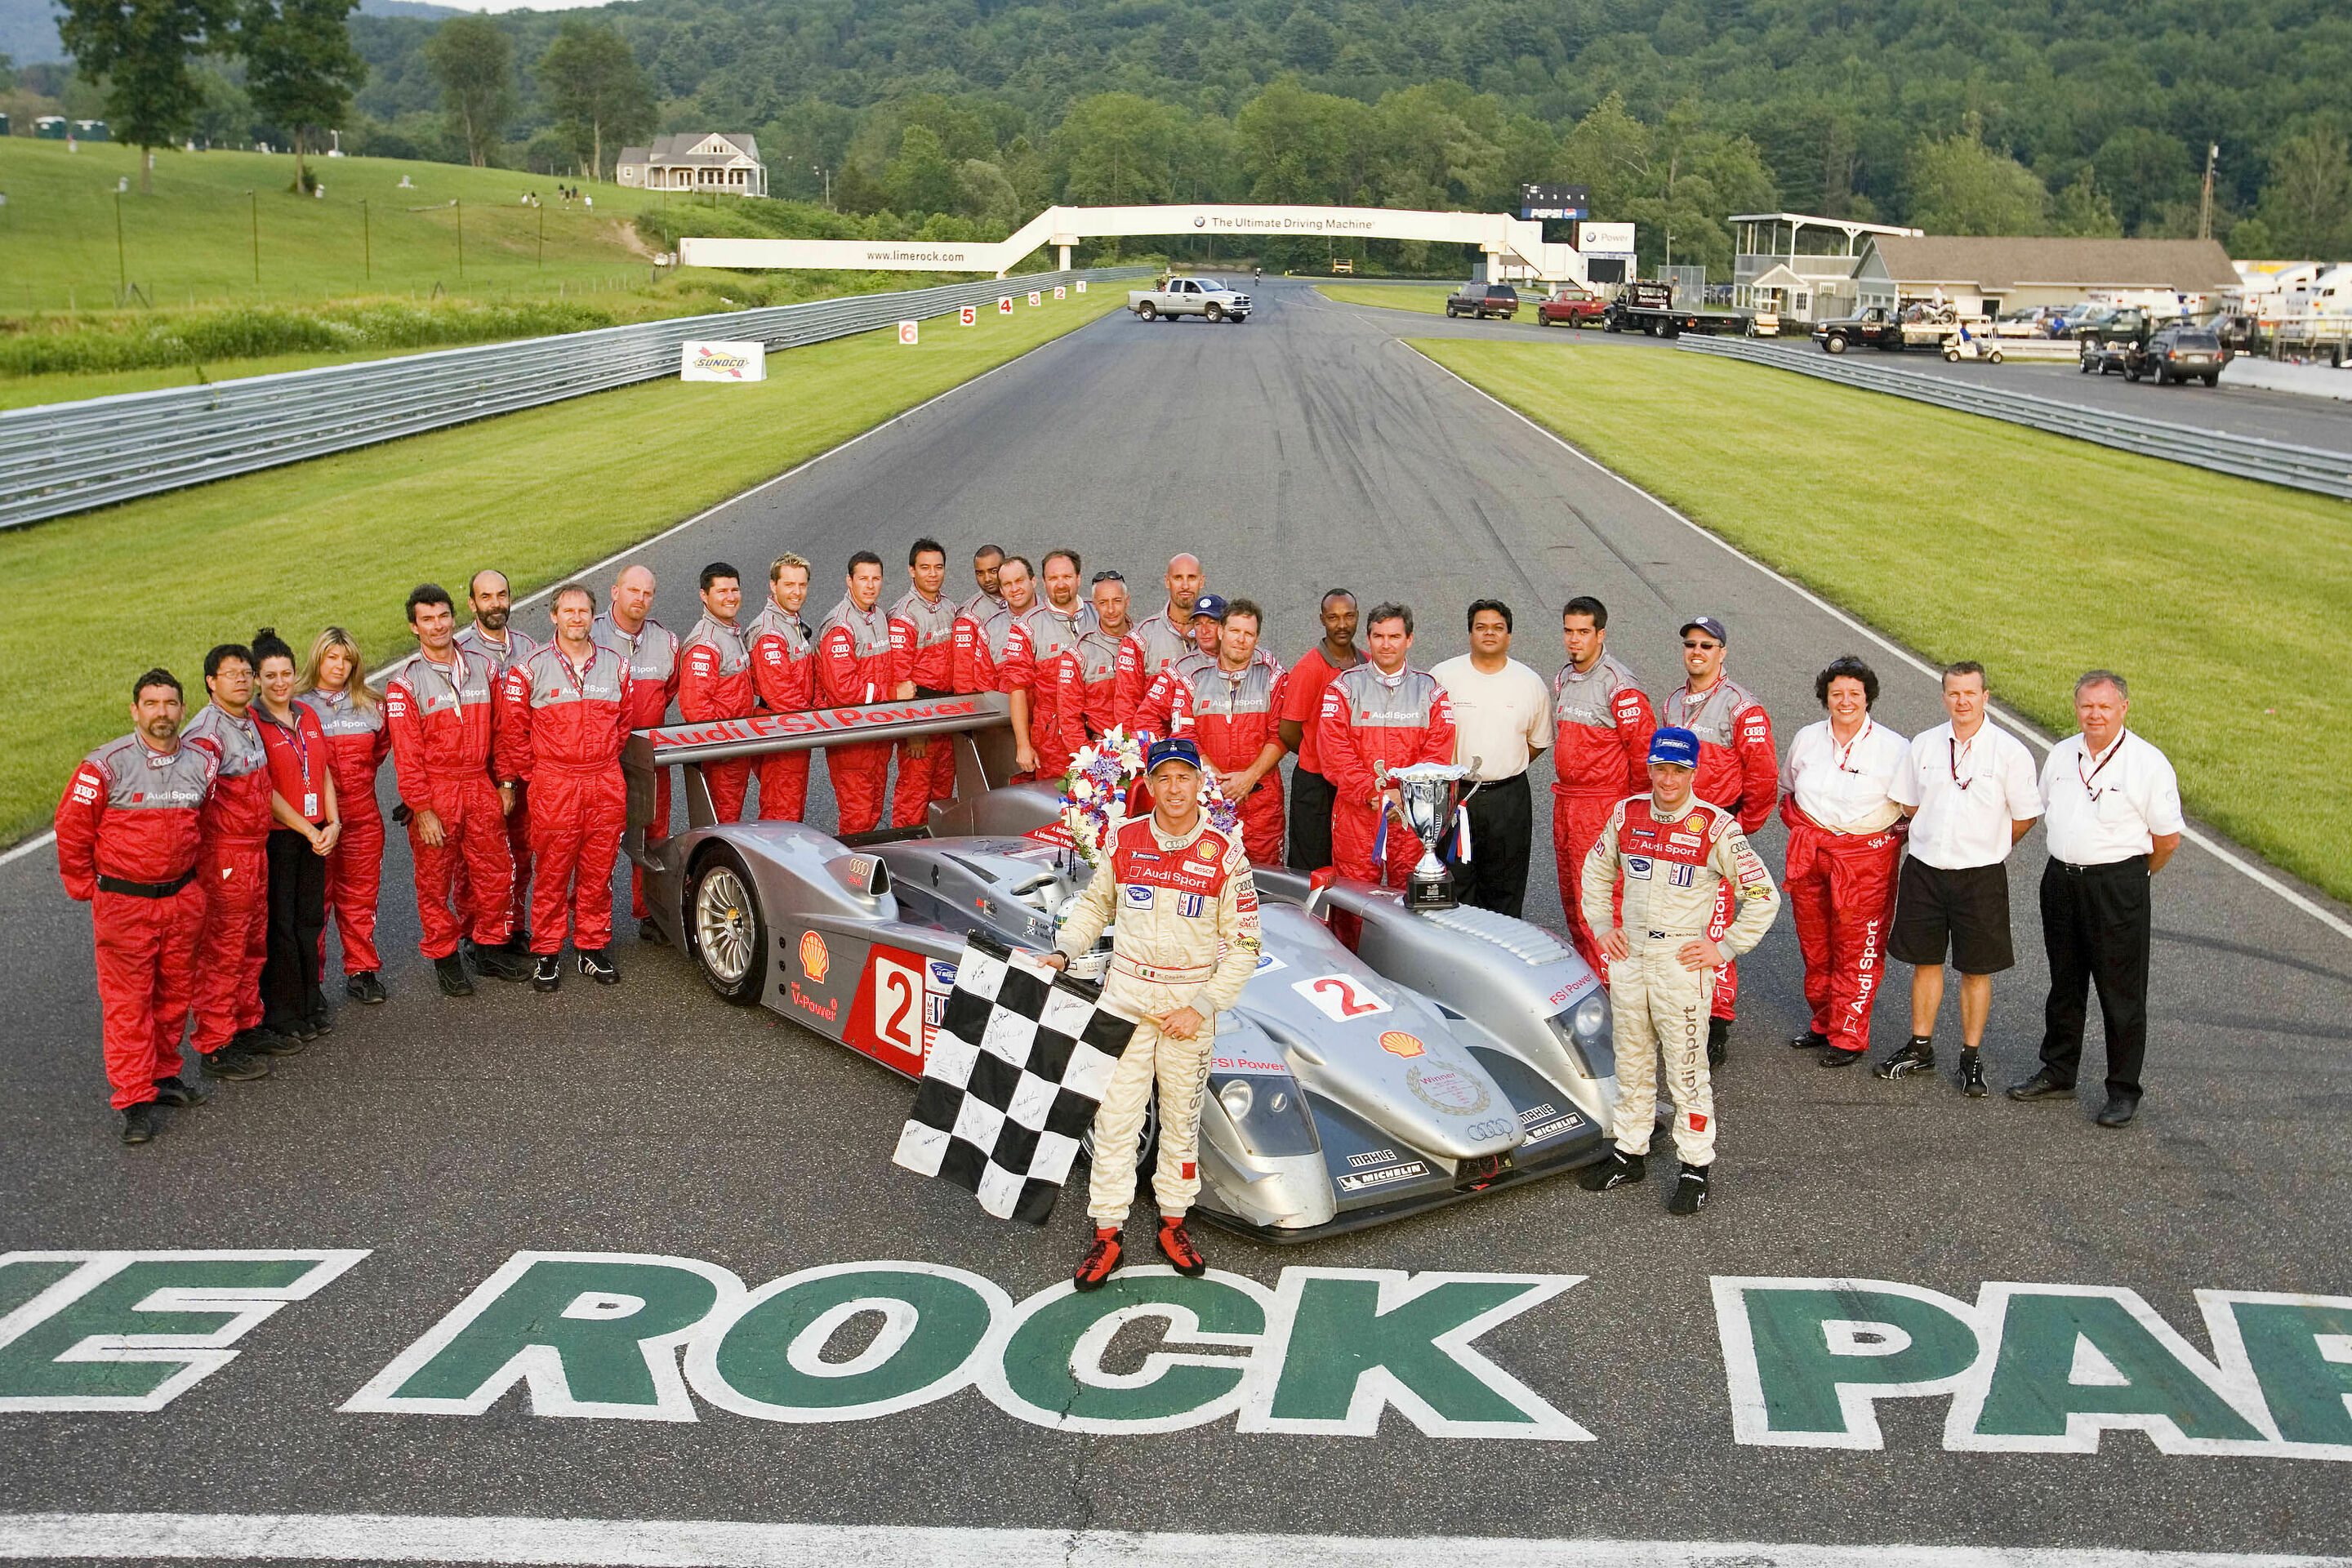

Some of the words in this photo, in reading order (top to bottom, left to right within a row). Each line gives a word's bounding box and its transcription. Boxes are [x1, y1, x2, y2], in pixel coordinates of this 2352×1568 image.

[1530, 208, 1564, 219] PEPSI
[1212, 216, 1232, 227] The
[1236, 217, 1281, 228] Ultimate
[1284, 218, 1323, 229] Driving
[1326, 219, 1372, 229] Machine
[1601, 233, 1628, 243] Power
[866, 250, 964, 263] www.limerock.com
[1055, 287, 1064, 299] 2
[1079, 282, 1085, 291] 1
[1000, 298, 1012, 311] 4
[1030, 293, 1040, 305] 3
[961, 309, 974, 324] 5
[901, 323, 916, 342] 6
[697, 357, 745, 368] SUNOCO
[1239, 698, 1263, 708] Sport
[1393, 711, 1419, 720] Sport
[321, 720, 341, 730] udi
[648, 720, 747, 750] Audi
[746, 709, 826, 737] FSI
[831, 700, 976, 728] Power
[73, 795, 92, 805] Audi
[146, 792, 171, 800] Audi
[172, 791, 198, 801] Sport
[1681, 836, 1700, 846] BOSCH
[1640, 840, 1663, 852] Audi
[1664, 844, 1698, 857] Sport
[1193, 866, 1214, 875] BOSCH
[1671, 864, 1679, 884] IMSA
[1143, 867, 1171, 881] Audi
[1172, 871, 1208, 889] Sport
[1744, 888, 1771, 897] SUNOCO
[1179, 894, 1188, 916] IMSA
[1236, 939, 1261, 948] SUNOCO
[1859, 920, 1878, 970] Sport
[1548, 991, 1567, 1006] FSI
[1566, 973, 1593, 997] Power
[1851, 973, 1873, 1014] Audi
[1313, 978, 1379, 1017] 2
[791, 990, 837, 1022] V-Power
[885, 970, 911, 1048] 2
[1682, 1004, 1697, 1067] Sport
[1211, 1058, 1235, 1068] FSI
[1237, 1058, 1285, 1071] Power
[1189, 1048, 1210, 1111] Sport
[1420, 1072, 1456, 1085] Winner
[1533, 1116, 1578, 1138] MICHELIN
[1350, 1150, 1396, 1167] MAHLE
[1362, 1163, 1422, 1183] MICHELIN
[336, 1250, 1597, 1441] ROCK
